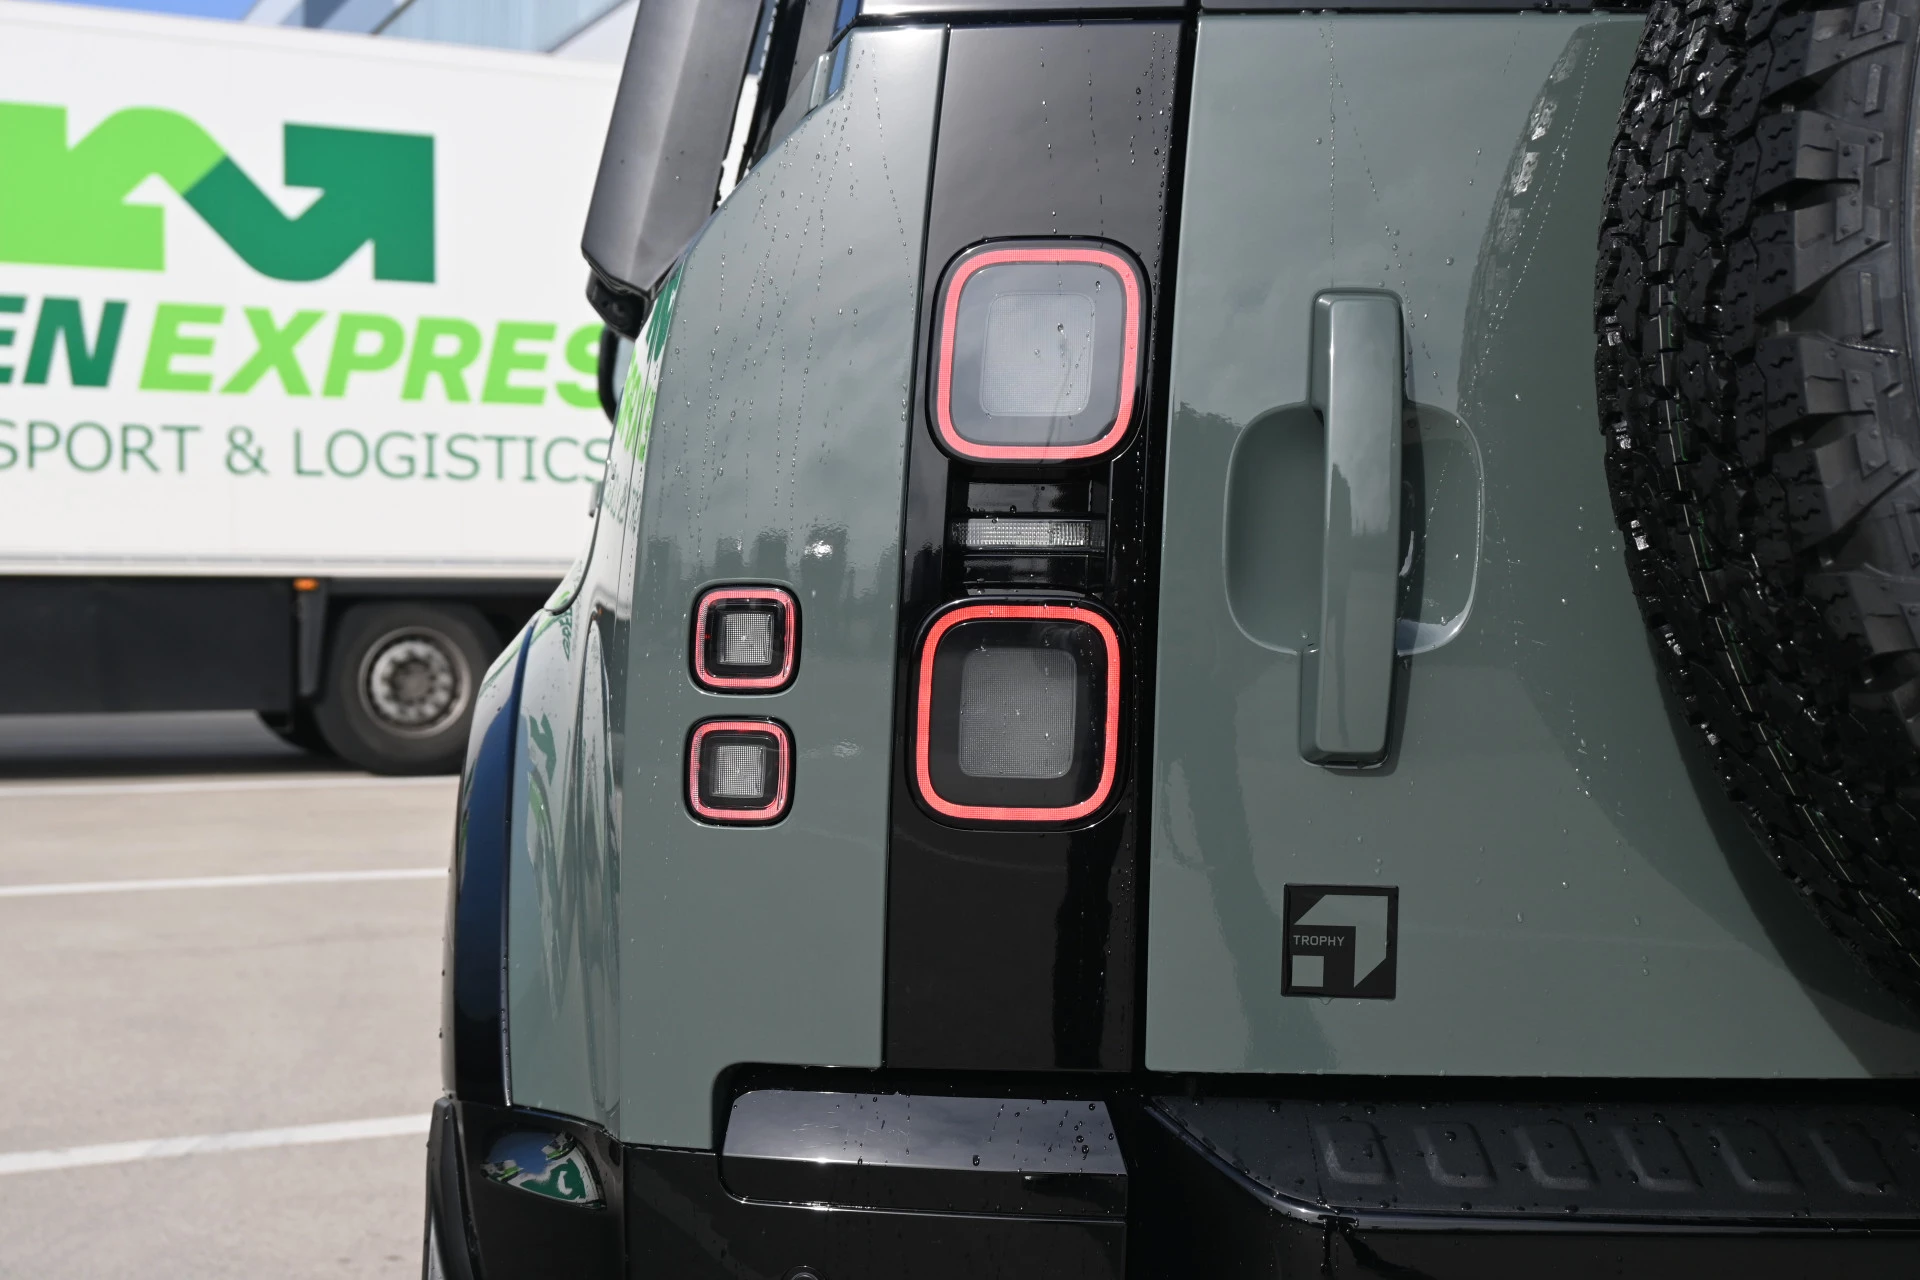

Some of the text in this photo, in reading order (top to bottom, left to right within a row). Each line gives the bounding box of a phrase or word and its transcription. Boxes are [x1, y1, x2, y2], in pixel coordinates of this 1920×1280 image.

[224, 425, 270, 477] &
[294, 428, 612, 484] LOGISTICS
[1292, 934, 1346, 947] TROPHY
